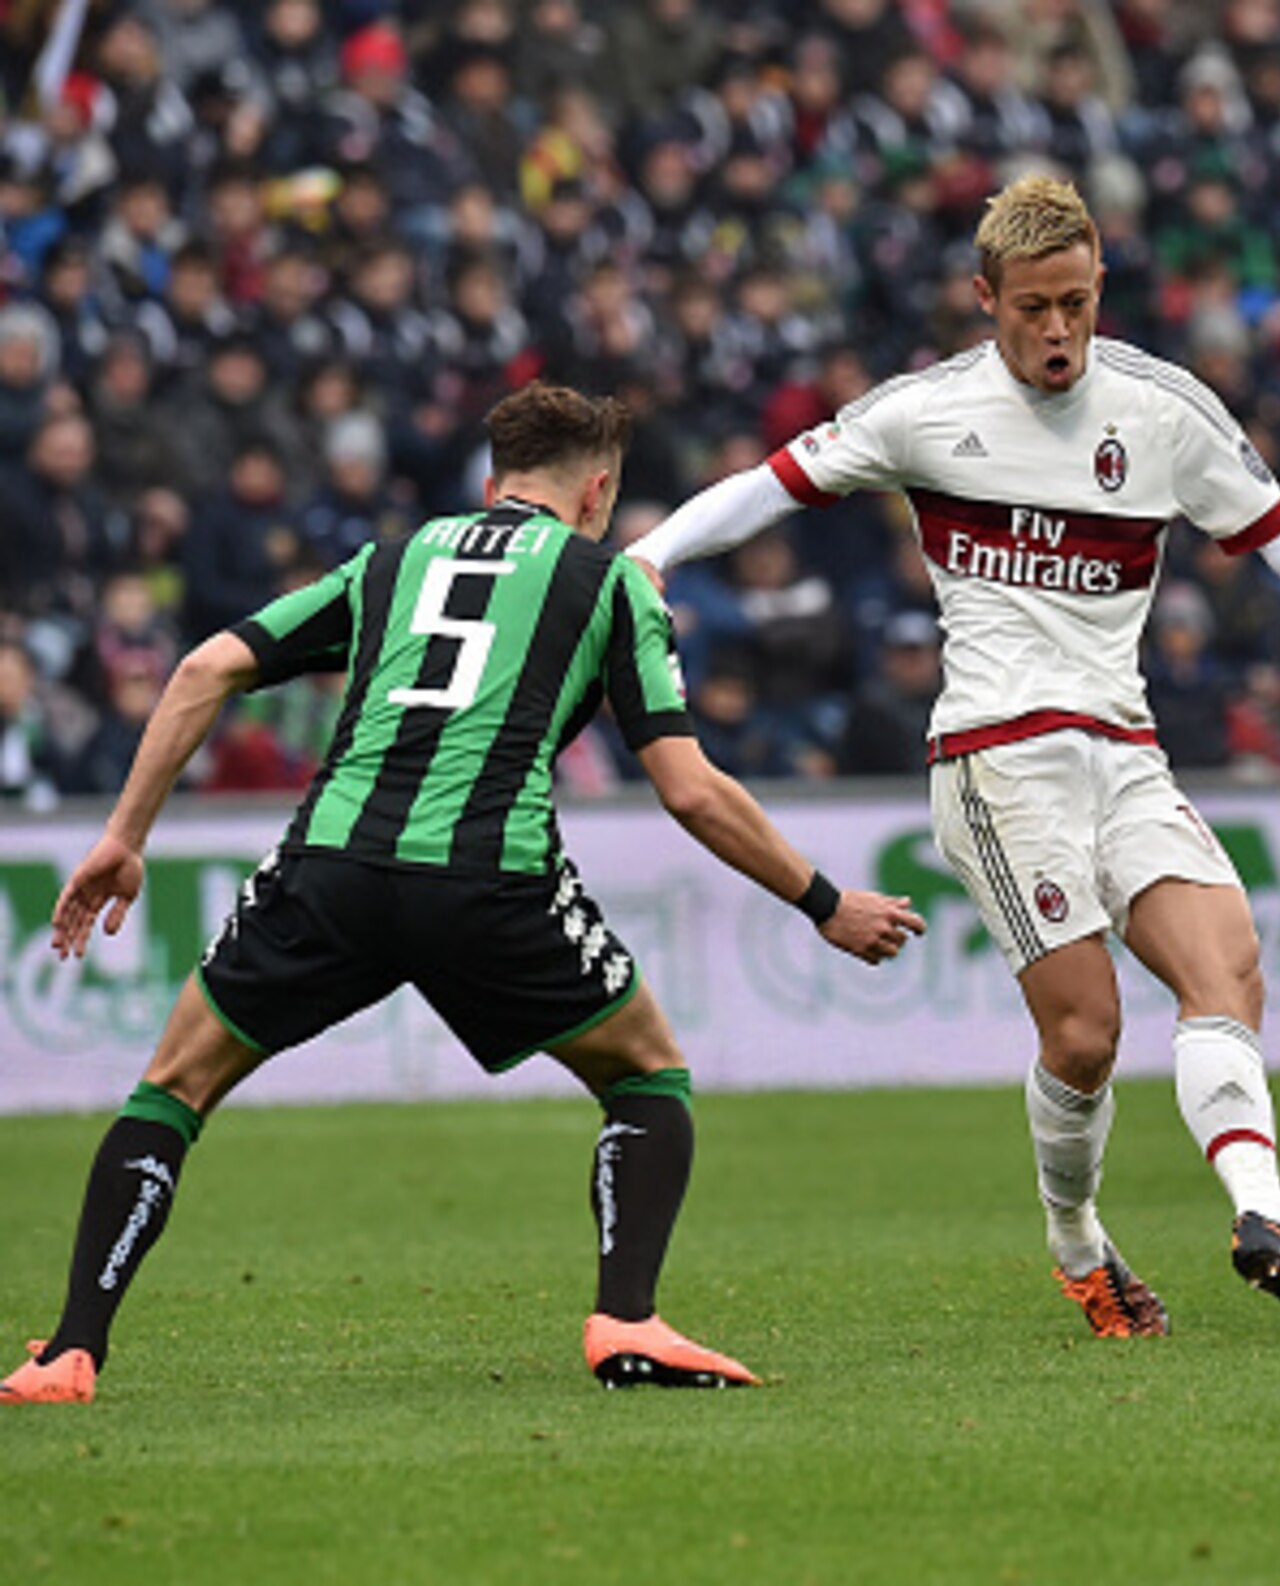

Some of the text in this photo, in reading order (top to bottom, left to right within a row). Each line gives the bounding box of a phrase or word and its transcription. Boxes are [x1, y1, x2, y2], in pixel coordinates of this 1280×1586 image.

[1010, 507, 1066, 548] Fly
[946, 528, 1122, 594] Emirates
[387, 556, 519, 711] 5
